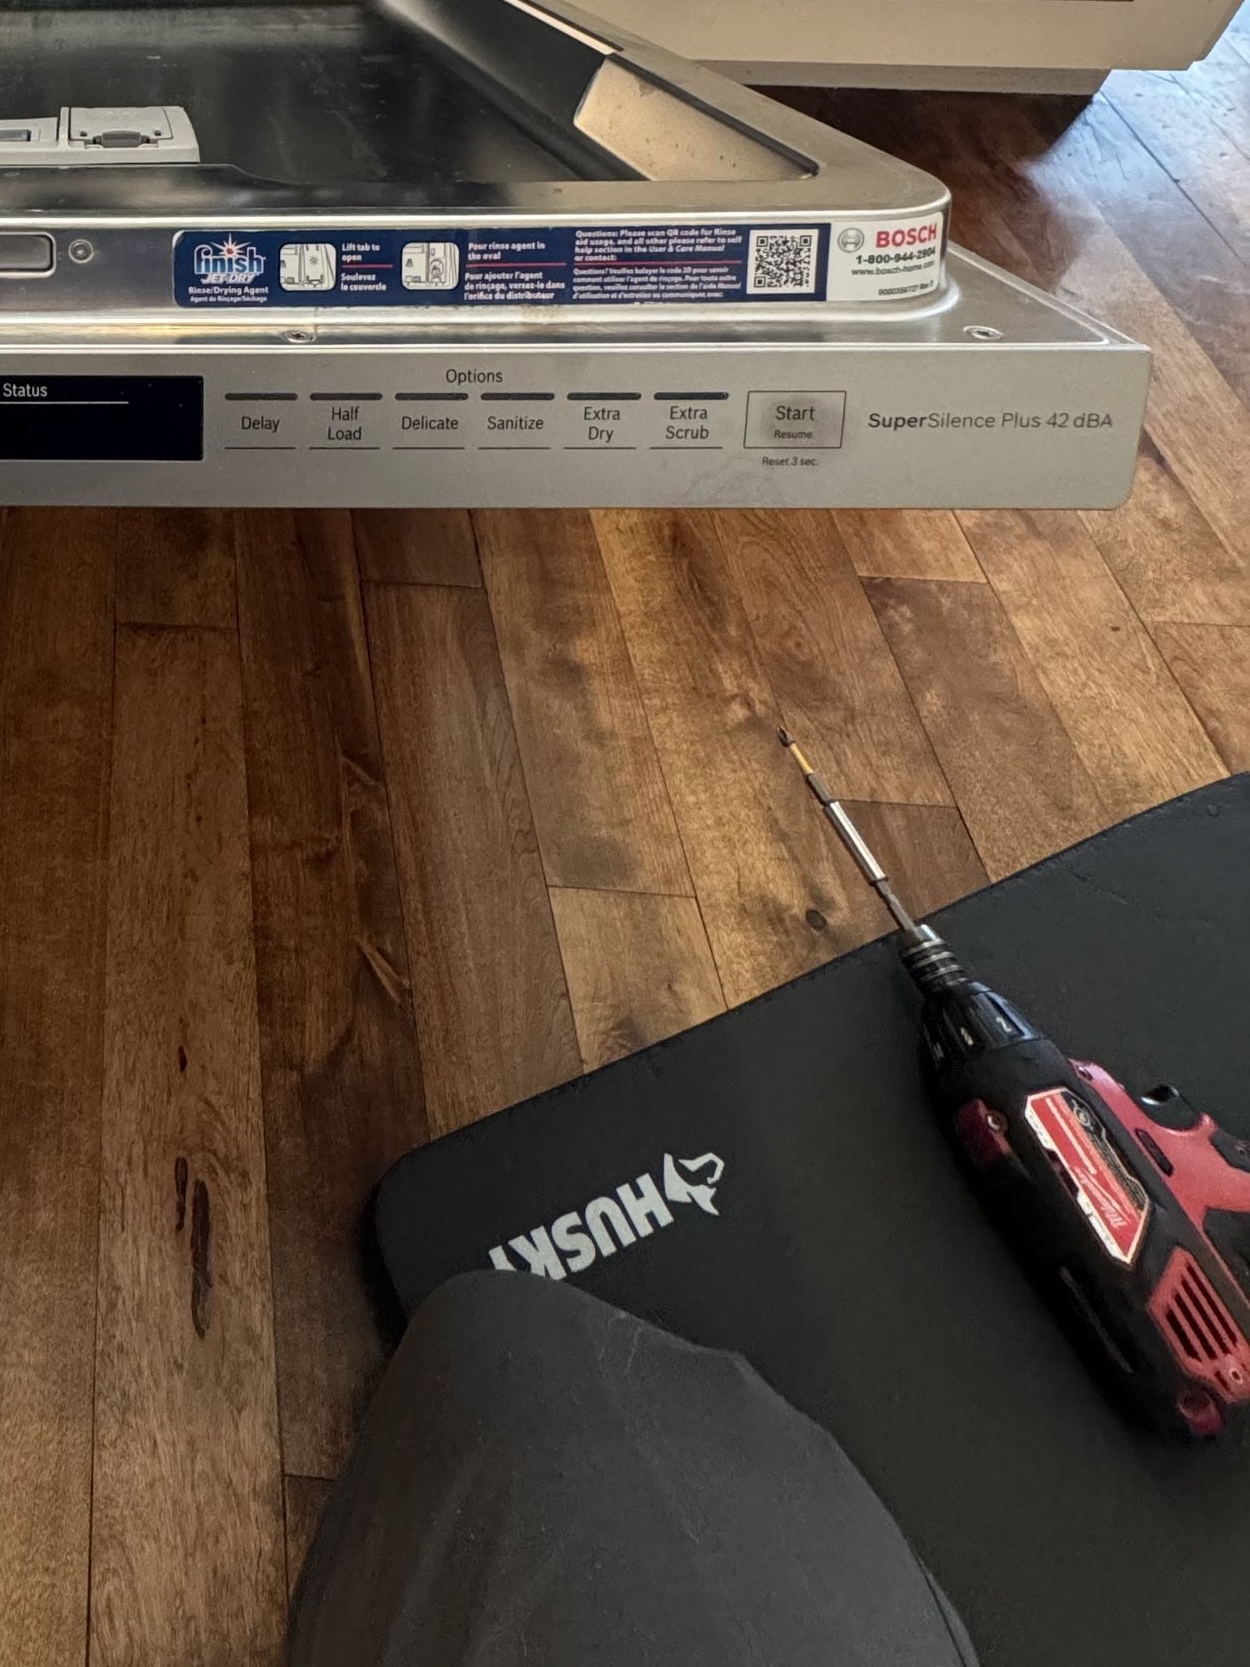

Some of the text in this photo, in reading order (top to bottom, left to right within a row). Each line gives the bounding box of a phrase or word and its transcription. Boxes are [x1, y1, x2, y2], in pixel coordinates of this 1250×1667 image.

[619, 229, 646, 237] Please
[666, 229, 679, 237] QR
[700, 228, 713, 236] for
[714, 228, 737, 236] Rinse
[876, 223, 938, 248] BOSCH
[341, 243, 381, 251] Lift tab to
[468, 241, 546, 251] Pour rinse agent in
[575, 238, 589, 246] aid
[589, 239, 616, 247] usage,
[633, 237, 645, 245] all
[645, 237, 667, 245] other
[668, 237, 695, 245] please
[696, 236, 716, 244] refer
[727, 236, 742, 244] self
[467, 251, 501, 260] the oval
[574, 246, 593, 254] help
[648, 245, 667, 253] User
[856, 246, 936, 265] 1-800-944-2904
[194, 244, 264, 275] finish
[341, 254, 362, 263] open
[465, 272, 483, 280] Pour
[188, 286, 269, 295] Rinse/Drying Agent
[464, 282, 474, 290] de
[545, 280, 566, 289] dans
[445, 368, 503, 385] Options
[2, 382, 48, 397] Status
[331, 406, 360, 421] Half
[583, 406, 621, 421] Extra
[669, 405, 708, 420] Extra
[775, 405, 816, 421] Start
[241, 416, 280, 433] Delay
[401, 415, 459, 431] Delicate
[487, 415, 544, 430] Sanitize
[868, 412, 1114, 431] SuperSilence Plus 42 dBA
[327, 426, 362, 441] Load
[588, 426, 614, 443] Dry
[665, 425, 710, 440] Scrub
[774, 429, 813, 439] Resume
[762, 456, 790, 466] Reset
[791, 456, 798, 466] 3
